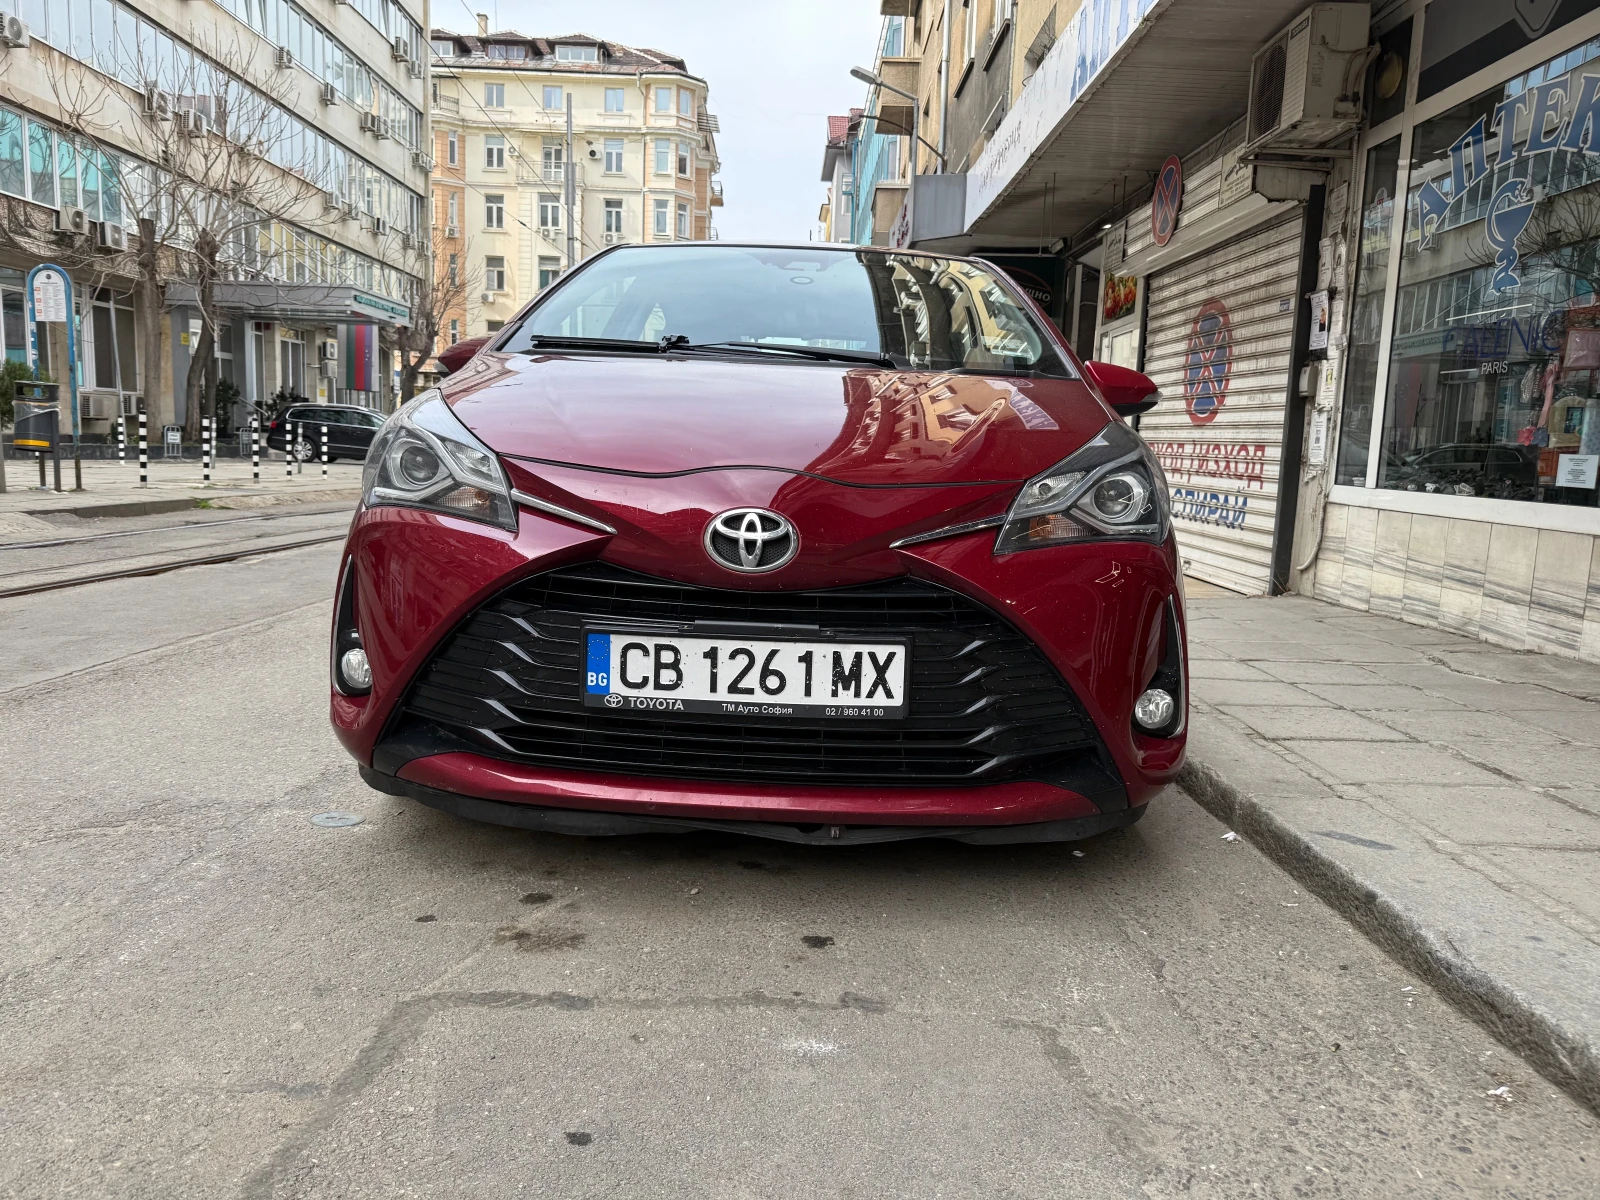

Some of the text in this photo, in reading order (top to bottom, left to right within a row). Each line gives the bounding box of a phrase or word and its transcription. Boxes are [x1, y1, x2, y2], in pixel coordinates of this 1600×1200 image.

[1480, 360, 1509, 375] PARIS
[619, 641, 897, 700] CB 1261 MX
[587, 671, 608, 687] BG
[628, 697, 684, 711] TOYOTA
[737, 704, 759, 715] Ауто
[761, 705, 793, 716] София
[825, 707, 837, 716] 02
[843, 707, 859, 717] 960
[860, 708, 871, 717] 41
[873, 708, 884, 717] 00
